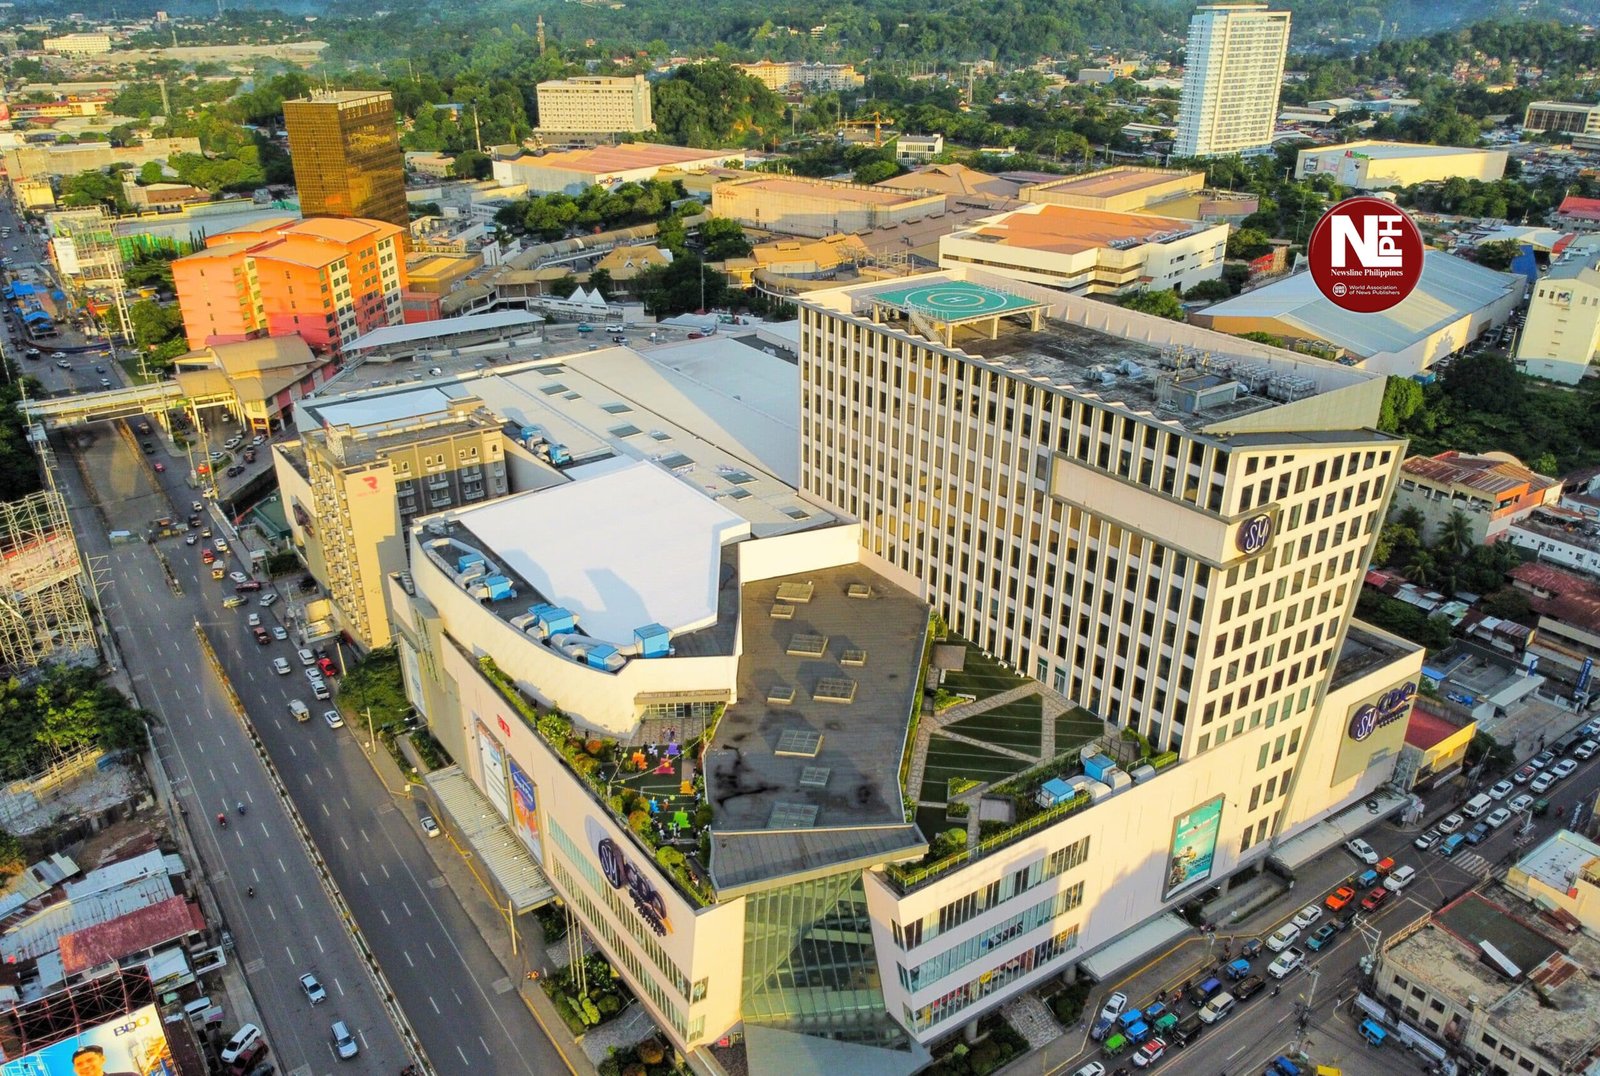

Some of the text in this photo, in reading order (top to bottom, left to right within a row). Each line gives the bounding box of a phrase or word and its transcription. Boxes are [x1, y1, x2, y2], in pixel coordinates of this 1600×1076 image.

[1245, 515, 1270, 553] SM
[1355, 706, 1378, 741] SM
[113, 1016, 149, 1037] BDO
